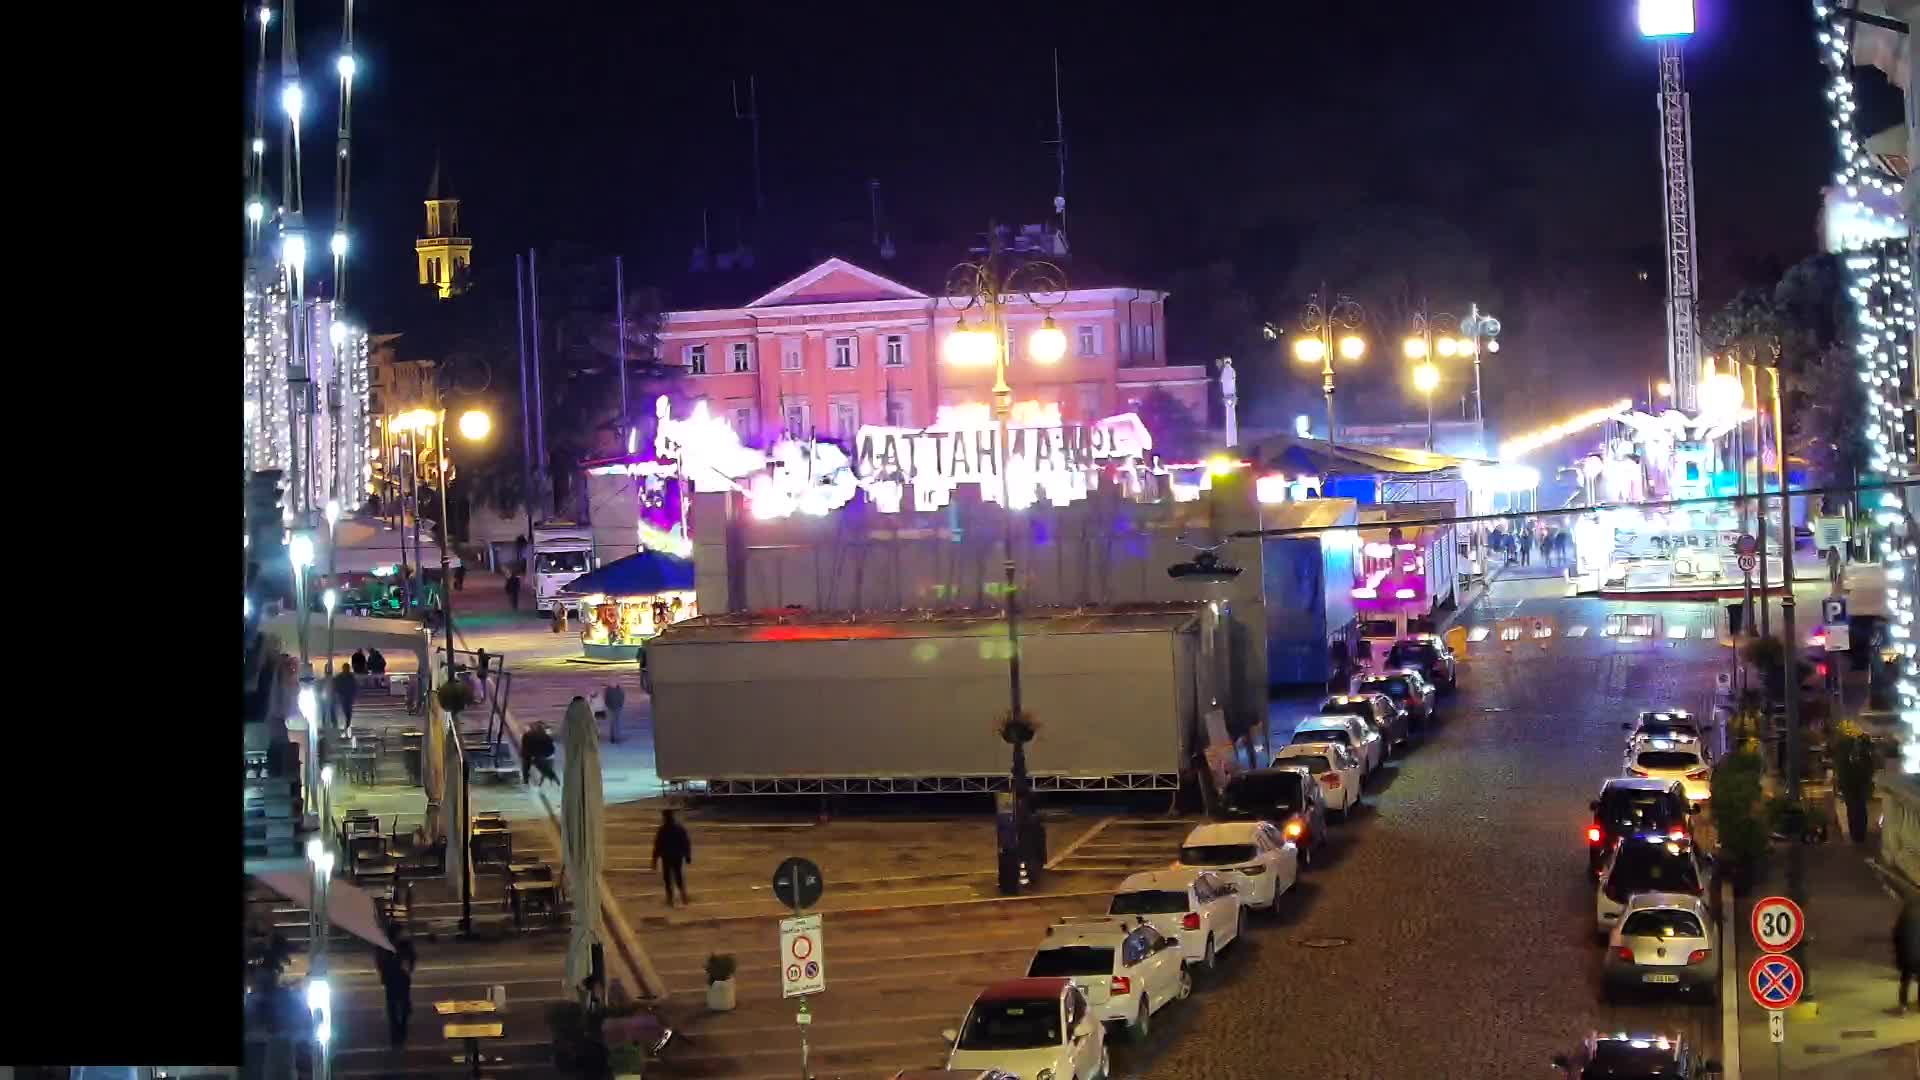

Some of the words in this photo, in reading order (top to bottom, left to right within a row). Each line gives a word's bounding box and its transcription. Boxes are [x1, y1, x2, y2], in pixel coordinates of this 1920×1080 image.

[1741, 557, 1753, 568] 20
[1825, 601, 1842, 624] P
[1762, 912, 1791, 937] 30
